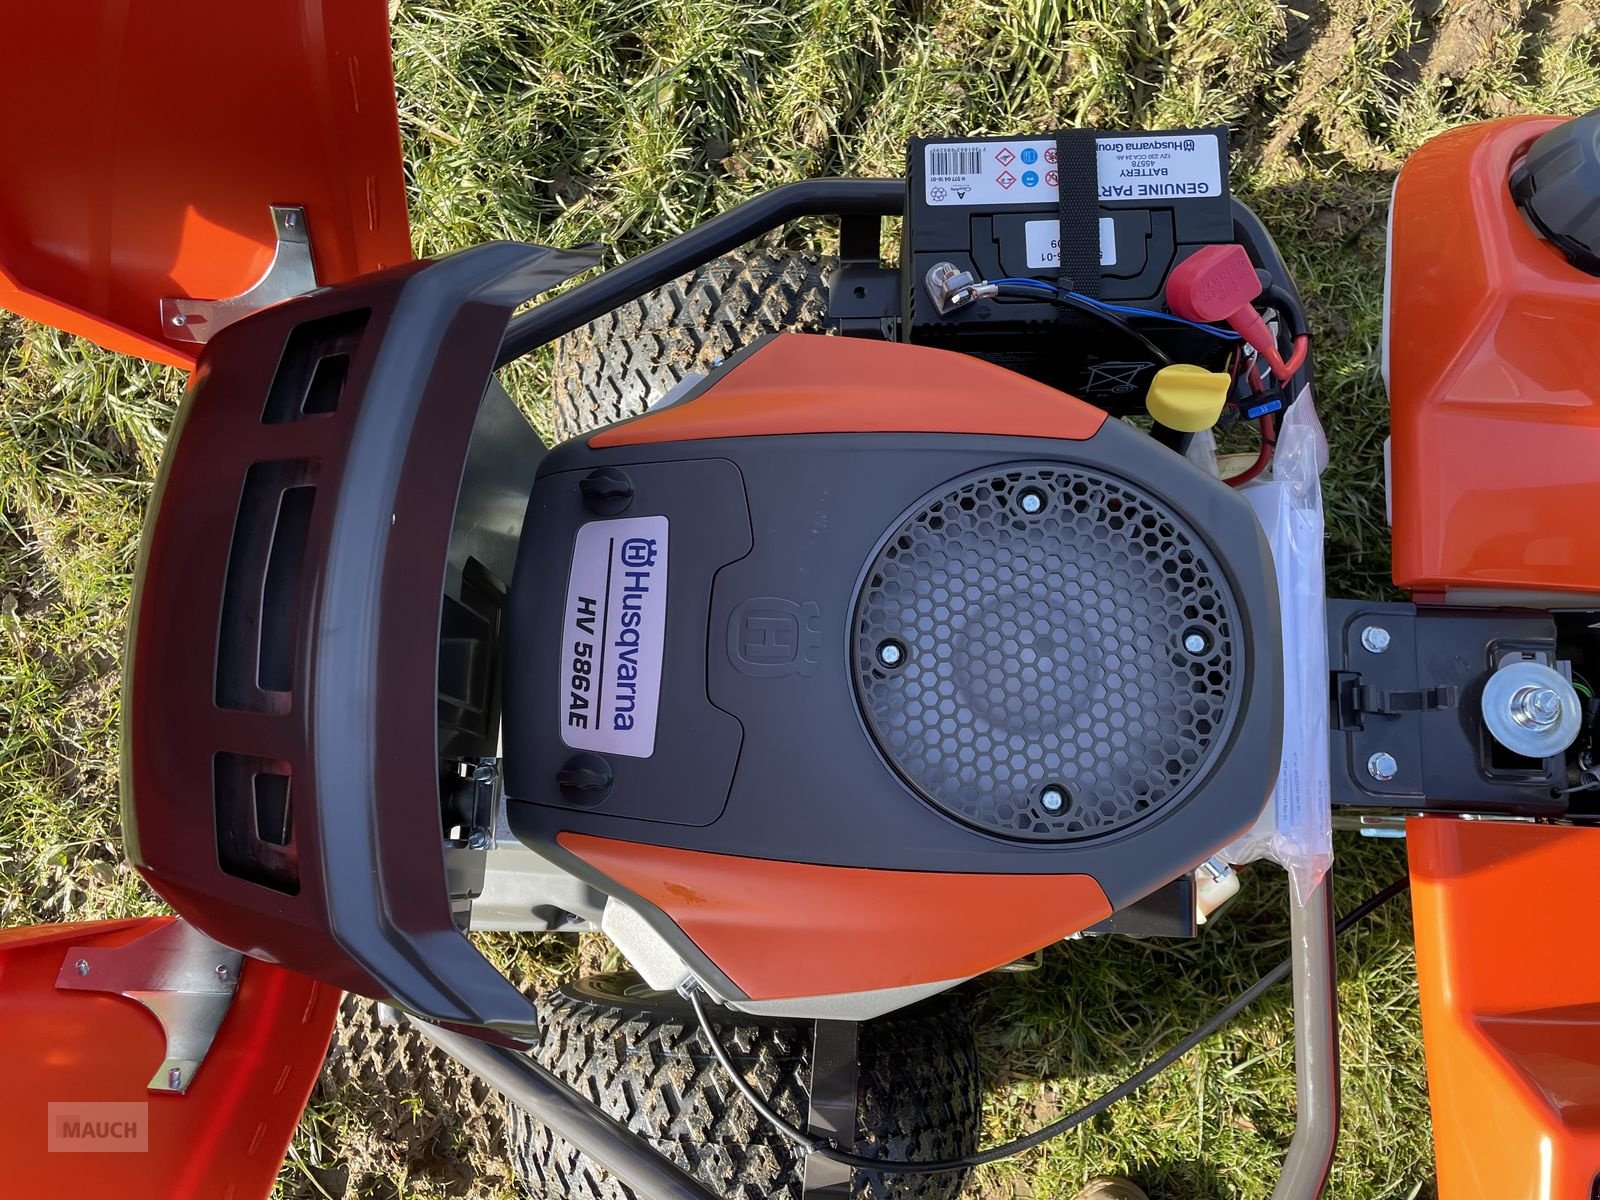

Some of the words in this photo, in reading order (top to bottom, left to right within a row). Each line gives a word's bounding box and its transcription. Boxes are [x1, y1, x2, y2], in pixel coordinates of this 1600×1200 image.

[1097, 142, 1124, 153] Grou
[1125, 140, 1183, 152] Husqvarna
[1119, 167, 1168, 178] BATTERY
[1098, 184, 1133, 197] PAR
[1138, 182, 1209, 196] GENUINE
[575, 596, 597, 635] HV
[613, 571, 651, 731] Husqvarna
[568, 641, 593, 730] 586AE
